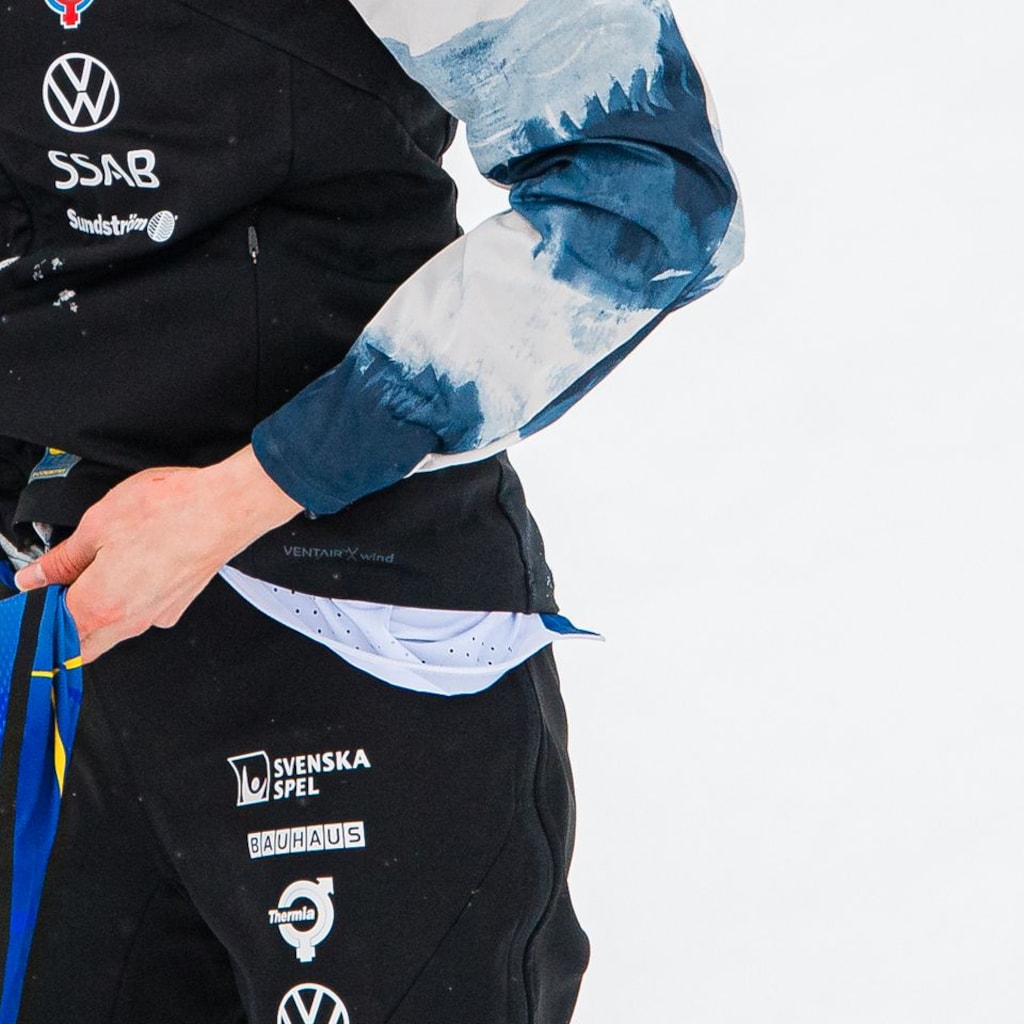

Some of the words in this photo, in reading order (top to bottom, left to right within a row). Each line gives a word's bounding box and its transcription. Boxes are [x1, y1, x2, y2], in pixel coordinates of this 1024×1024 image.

[47, 148, 161, 190] SSAB
[66, 208, 149, 237] Sundström
[359, 553, 396, 564] wind
[273, 748, 372, 778] SVENSKA
[272, 776, 321, 800] SPEL
[250, 826, 363, 856] BAUHAUS
[268, 905, 316, 925] Thermia
